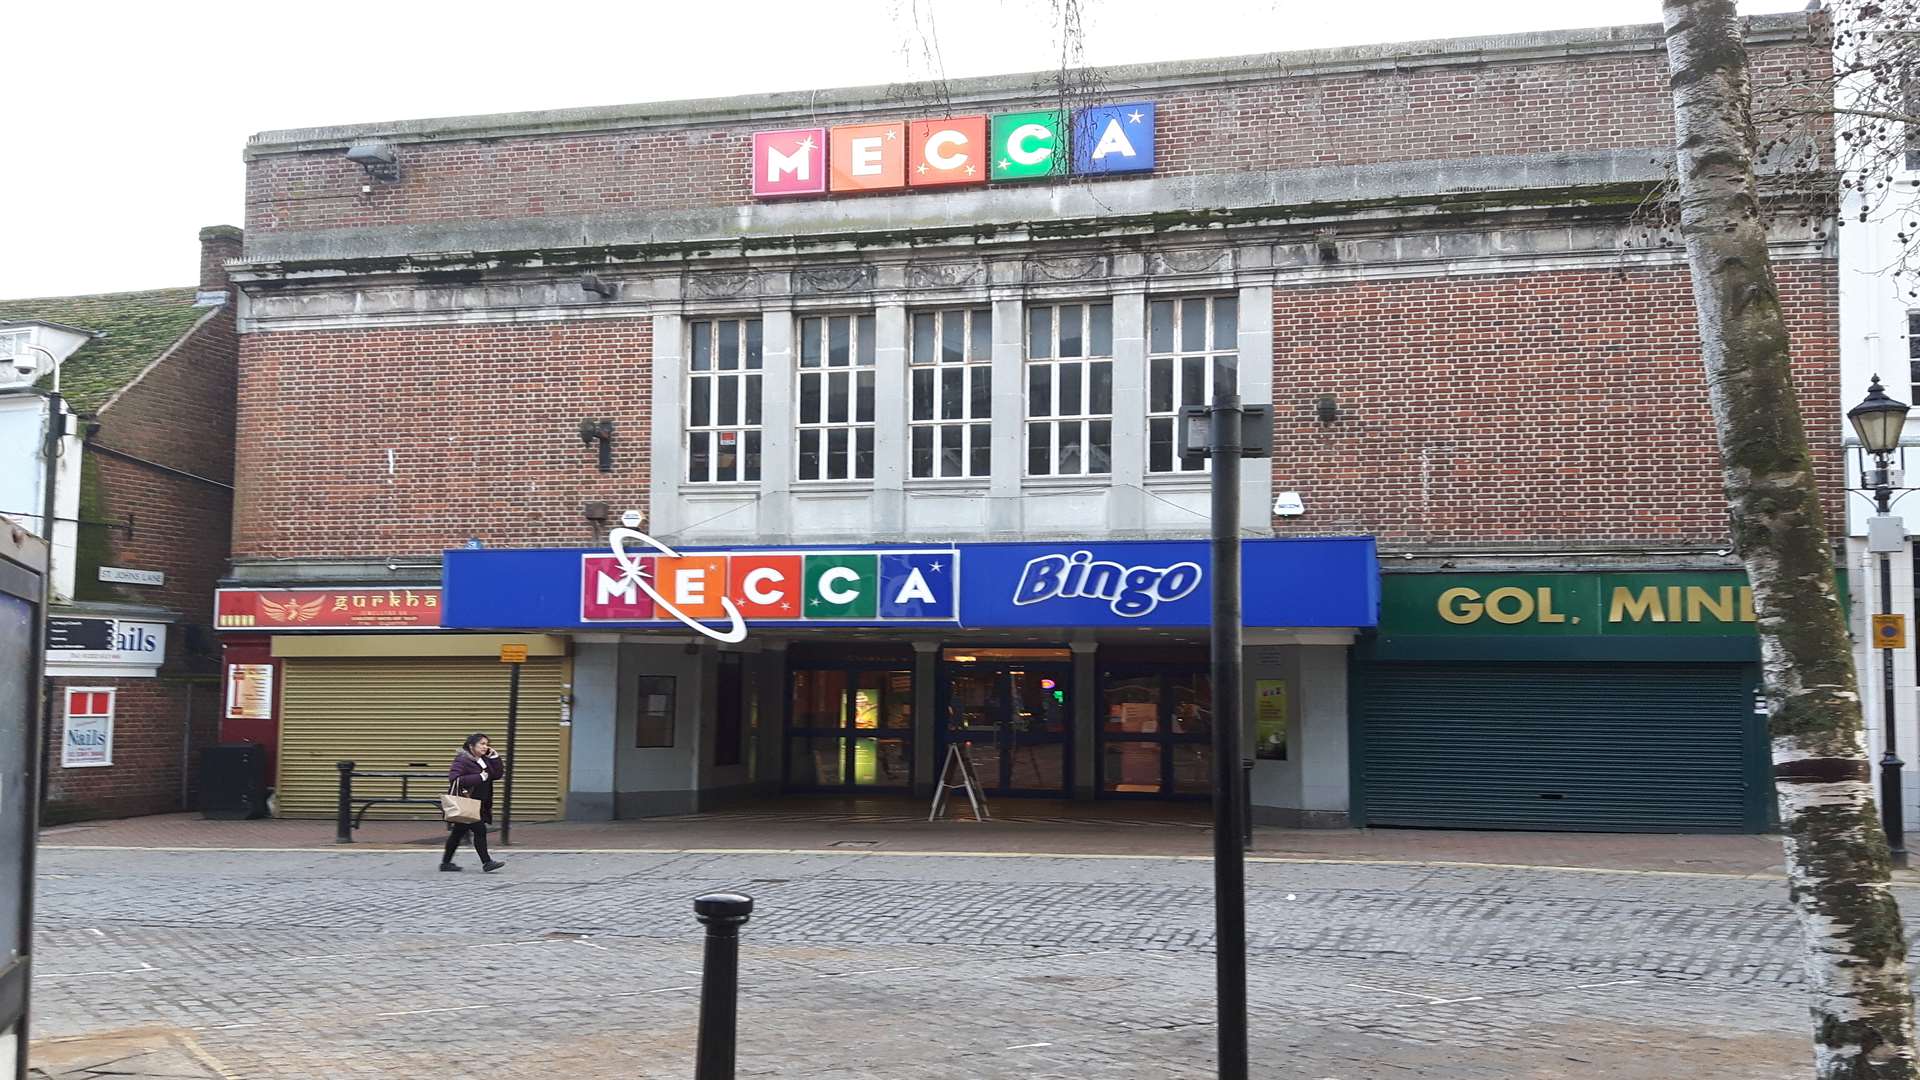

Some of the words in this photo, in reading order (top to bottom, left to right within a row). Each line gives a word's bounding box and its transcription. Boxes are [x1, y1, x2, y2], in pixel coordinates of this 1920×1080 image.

[767, 118, 1137, 182] MECCA
[331, 590, 438, 612] gurkha
[596, 566, 937, 605] MECCA
[1013, 550, 1203, 618] Bingo
[1437, 586, 1581, 624] GOL
[117, 627, 157, 652] ails
[67, 728, 106, 747] Nails
